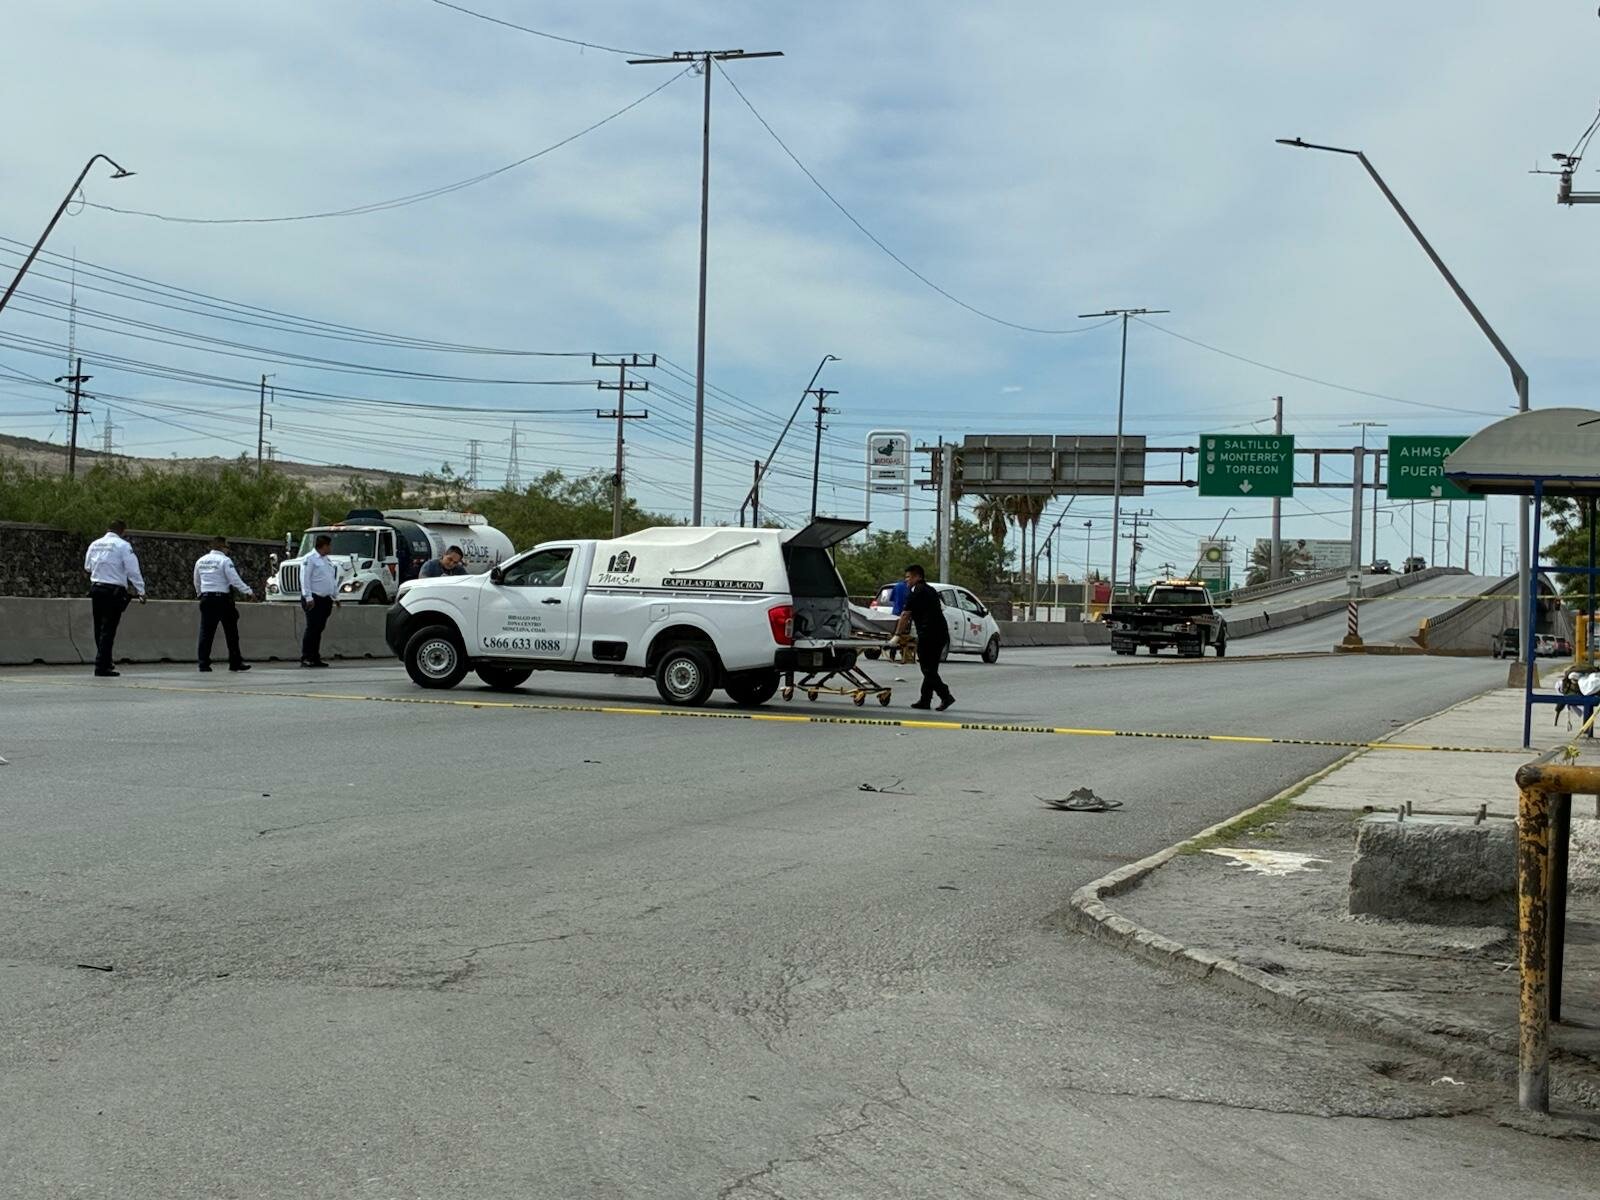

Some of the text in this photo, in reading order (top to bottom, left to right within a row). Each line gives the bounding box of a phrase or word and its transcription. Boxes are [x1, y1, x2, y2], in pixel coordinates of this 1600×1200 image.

[1224, 440, 1280, 450] SALTILLO
[1400, 447, 1451, 457] AHMSA
[1220, 453, 1287, 462] MONTERREY
[1225, 465, 1279, 475] TORREON
[1400, 466, 1444, 477] PUERT
[663, 579, 705, 587] CAPILLAS
[705, 580, 717, 588] DE
[488, 637, 560, 651] 866 633 0888
